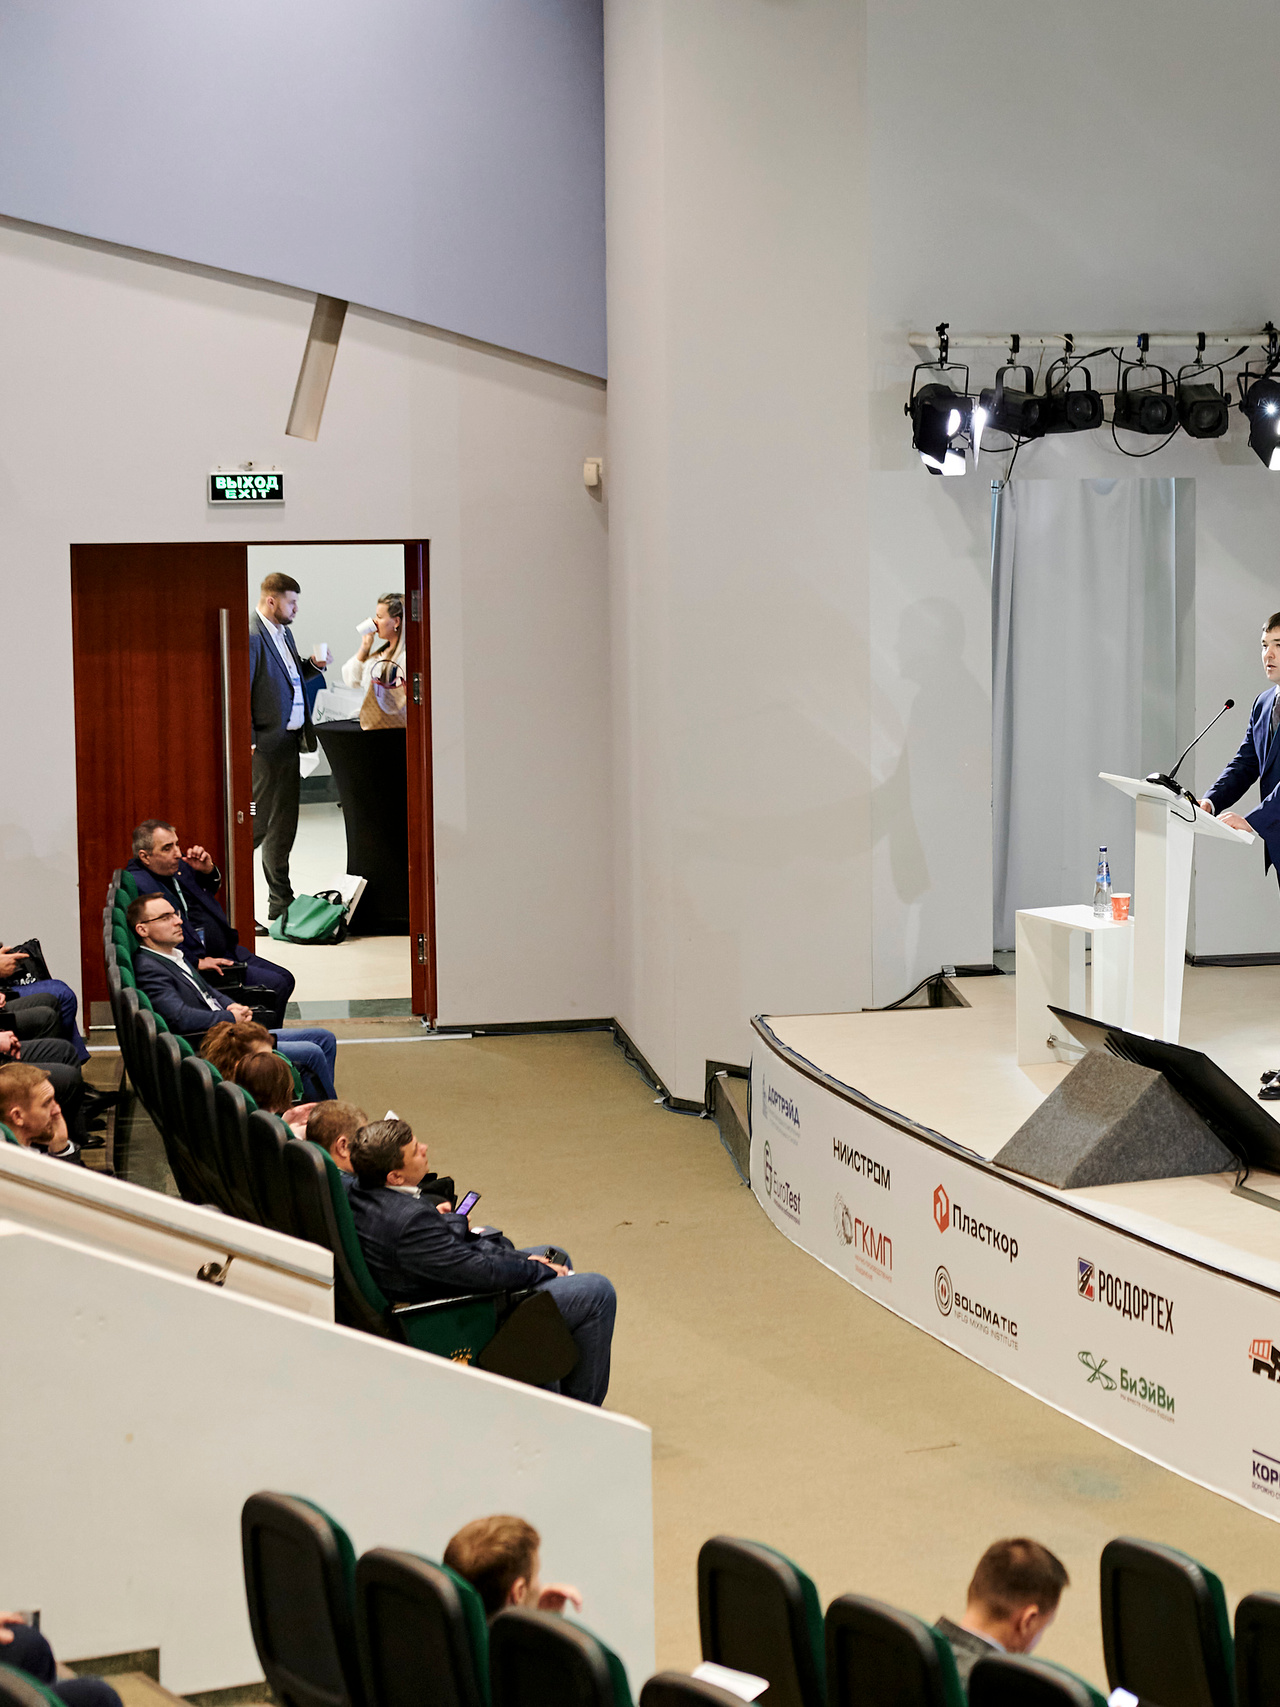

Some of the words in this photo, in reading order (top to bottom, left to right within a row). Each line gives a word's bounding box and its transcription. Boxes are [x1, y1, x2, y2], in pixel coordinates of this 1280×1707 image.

[215, 476, 279, 490] ВЫХОД
[225, 489, 270, 499] EXIT
[832, 1137, 892, 1191] НИИСТРОМ
[773, 1170, 801, 1215] EuroTest
[854, 1217, 893, 1271] ГКМП
[953, 1203, 1019, 1263] Пласткор
[954, 1292, 1018, 1337] SOLOMATIC
[1099, 1269, 1174, 1335] РОСДОРТЕХ
[1120, 1367, 1175, 1415] БиЭйВи
